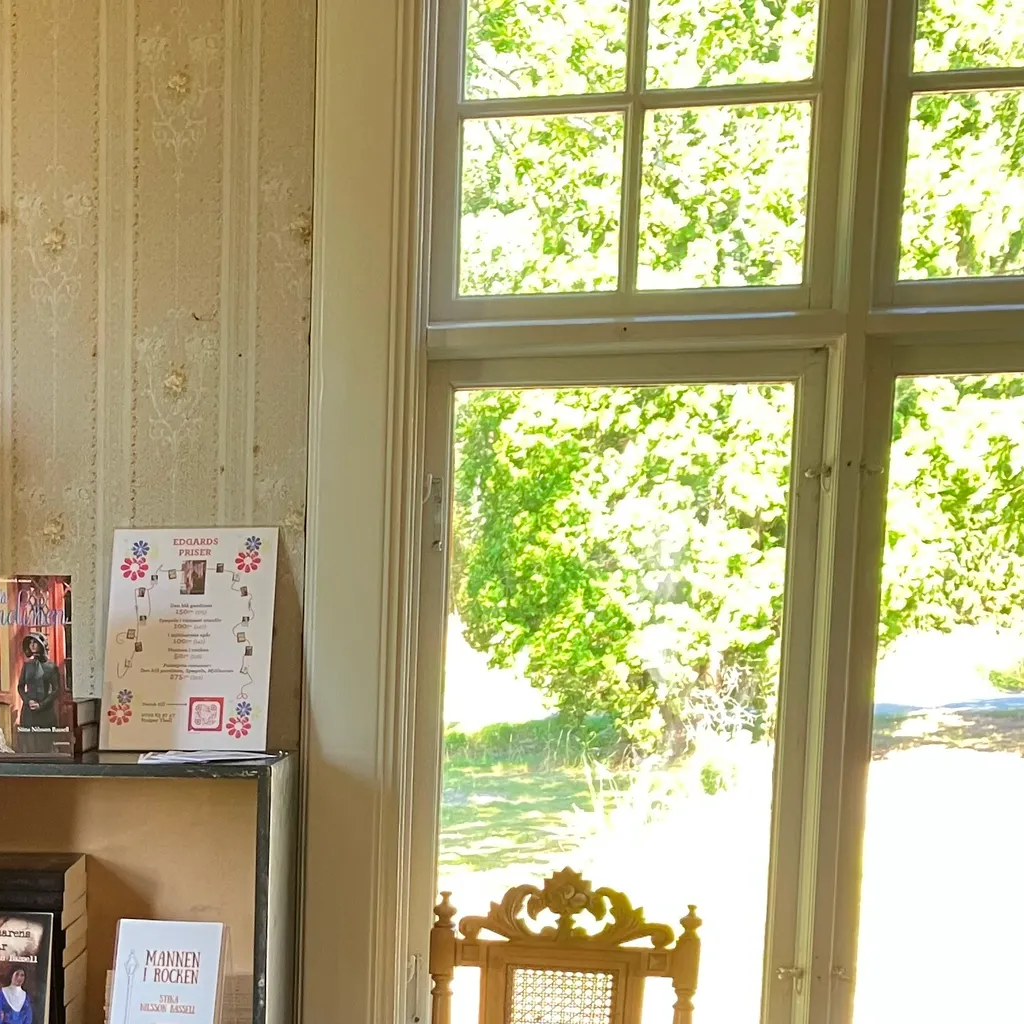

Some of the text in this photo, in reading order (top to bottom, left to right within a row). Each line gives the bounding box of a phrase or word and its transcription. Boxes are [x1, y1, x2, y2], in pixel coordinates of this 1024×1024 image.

[173, 538, 219, 546] EDGARDS
[145, 949, 201, 968] MANNEN
[143, 967, 199, 984] I ROCKEN
